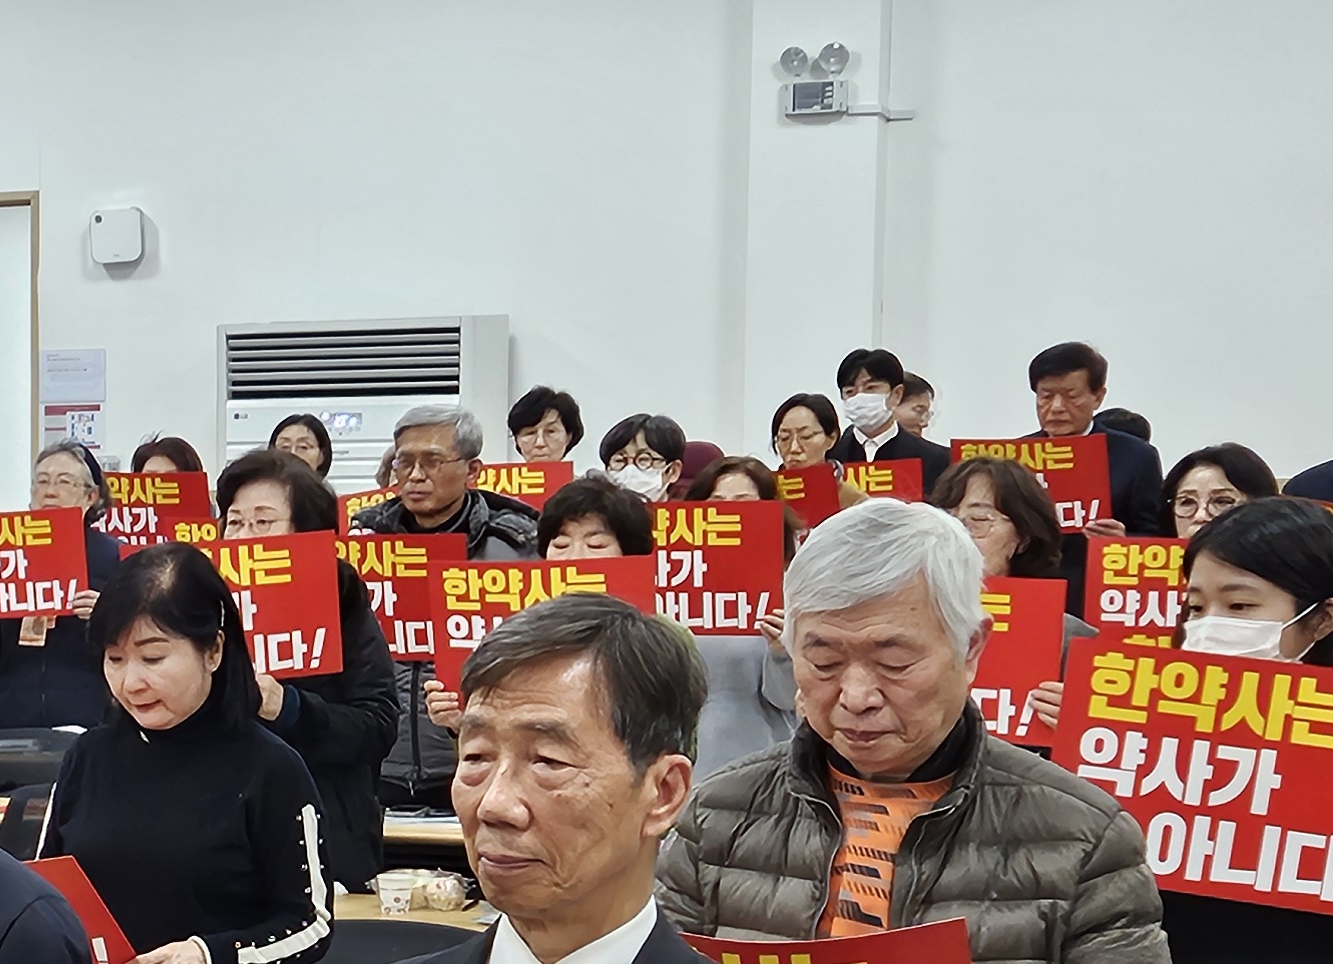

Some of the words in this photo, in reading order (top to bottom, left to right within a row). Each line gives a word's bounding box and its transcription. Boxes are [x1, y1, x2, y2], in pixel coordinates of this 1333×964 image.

[206, 543, 292, 587] 사는
[1099, 589, 1187, 628] 약사
[446, 614, 495, 651] 약
[1088, 651, 1333, 750] 한약사는
[1077, 726, 1282, 817] 약사가
